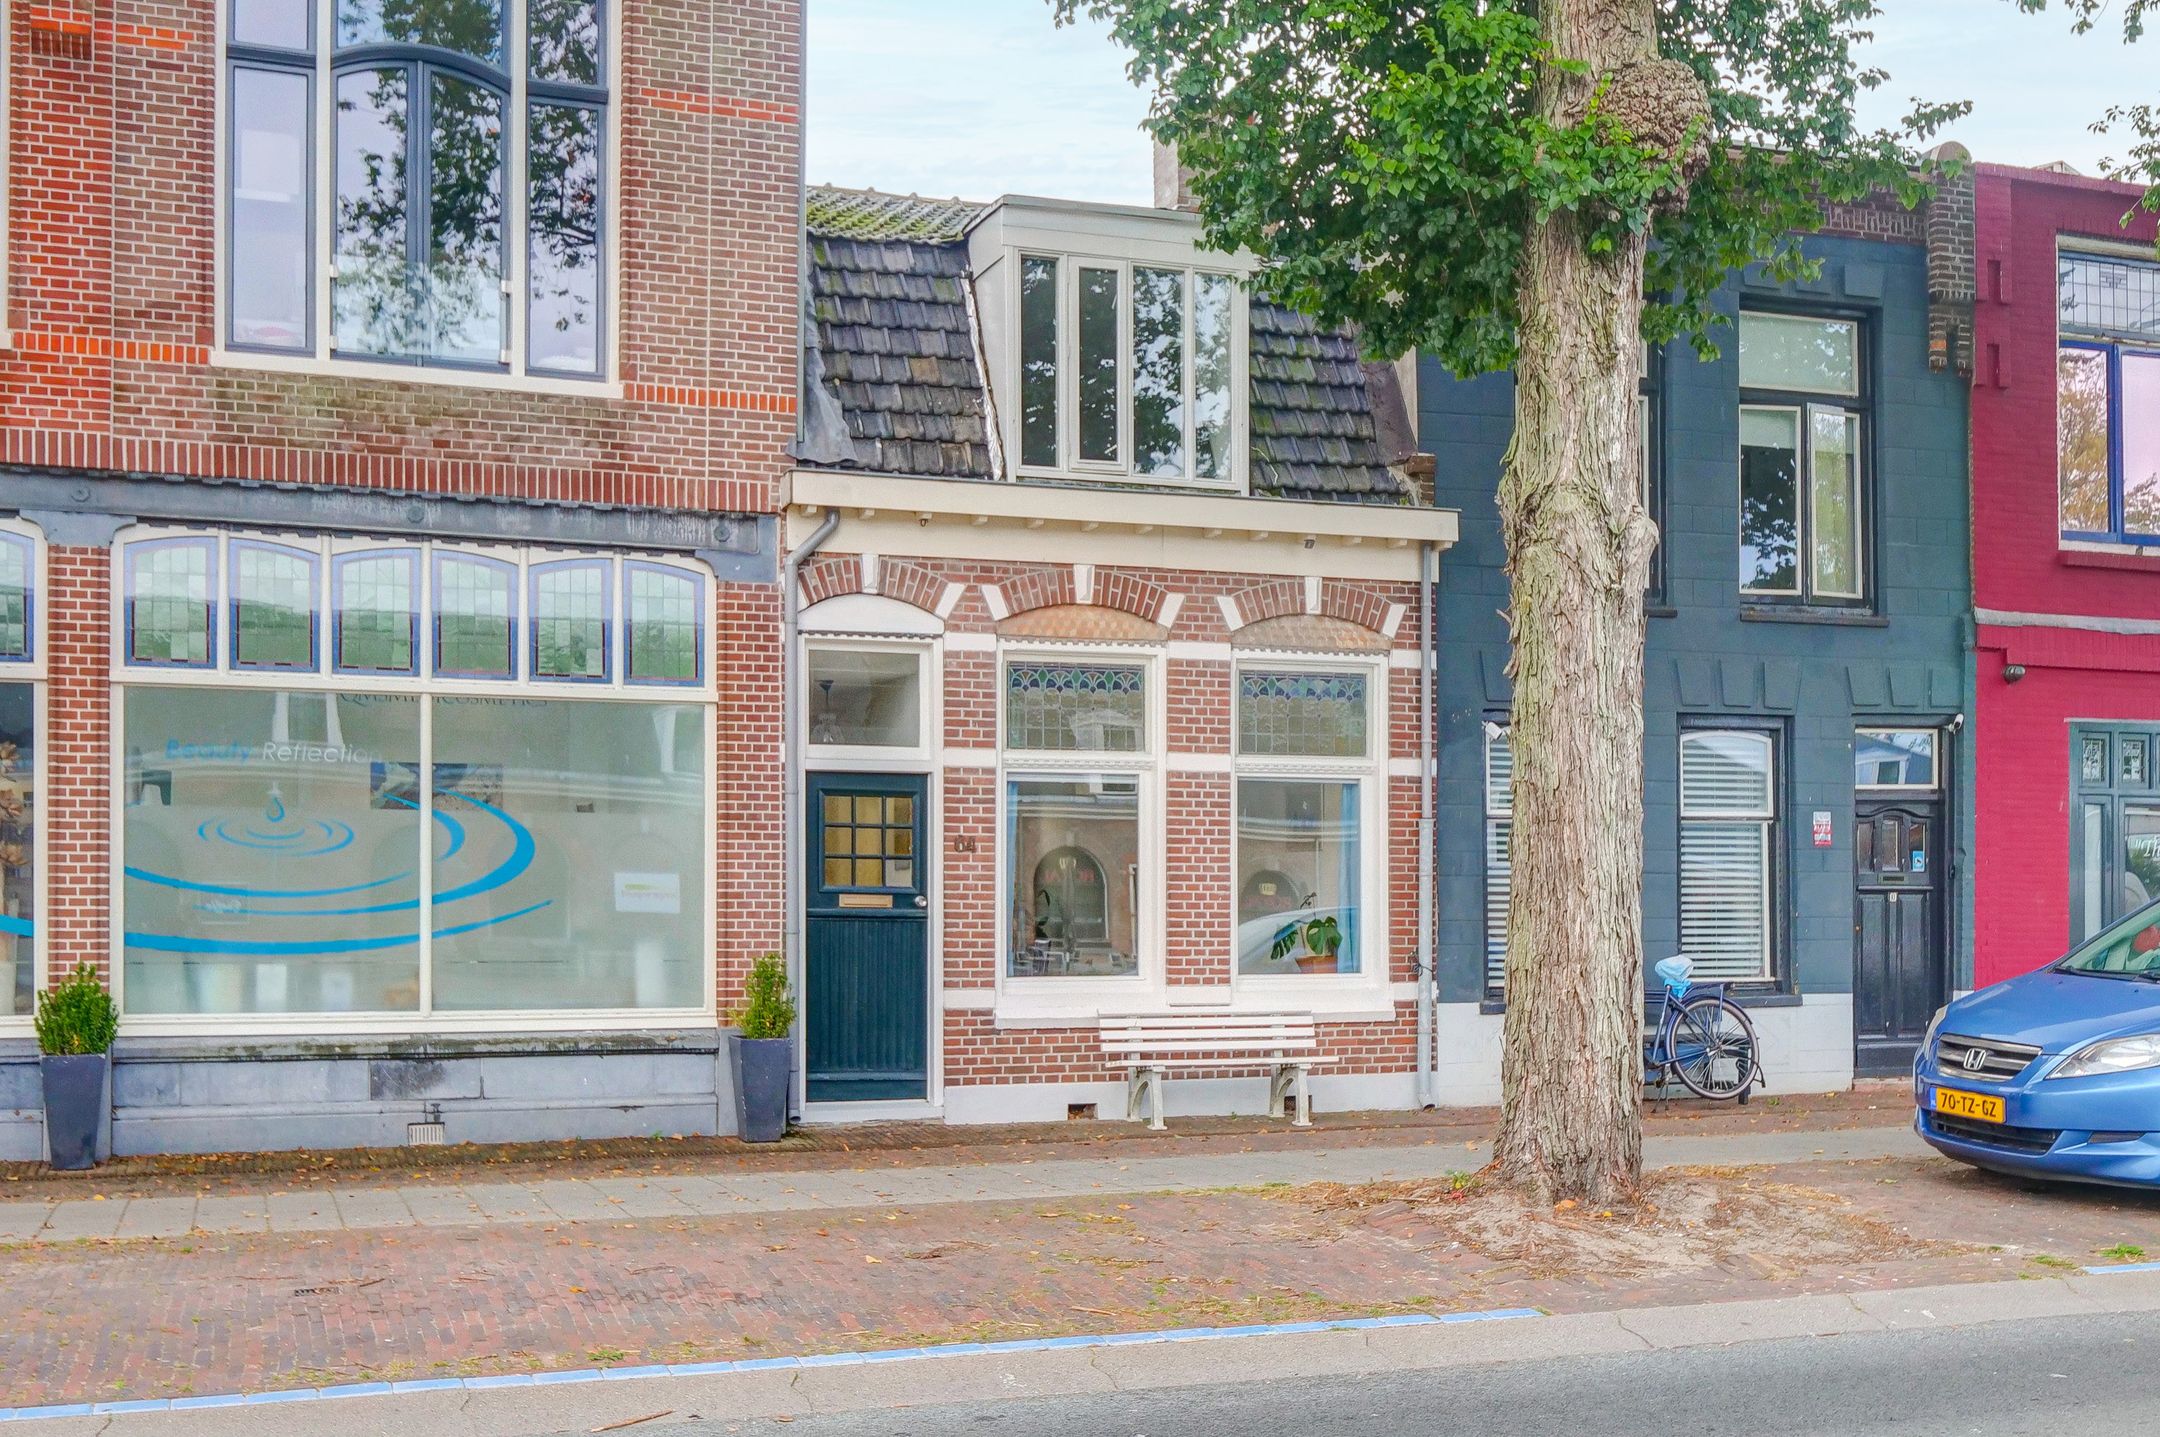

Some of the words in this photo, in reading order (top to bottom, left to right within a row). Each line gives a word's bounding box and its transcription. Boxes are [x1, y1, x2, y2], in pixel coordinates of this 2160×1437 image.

[165, 738, 252, 763] Beauty
[262, 741, 383, 763] Reflection
[1941, 1092, 1997, 1117] 70-TZ-GZ
